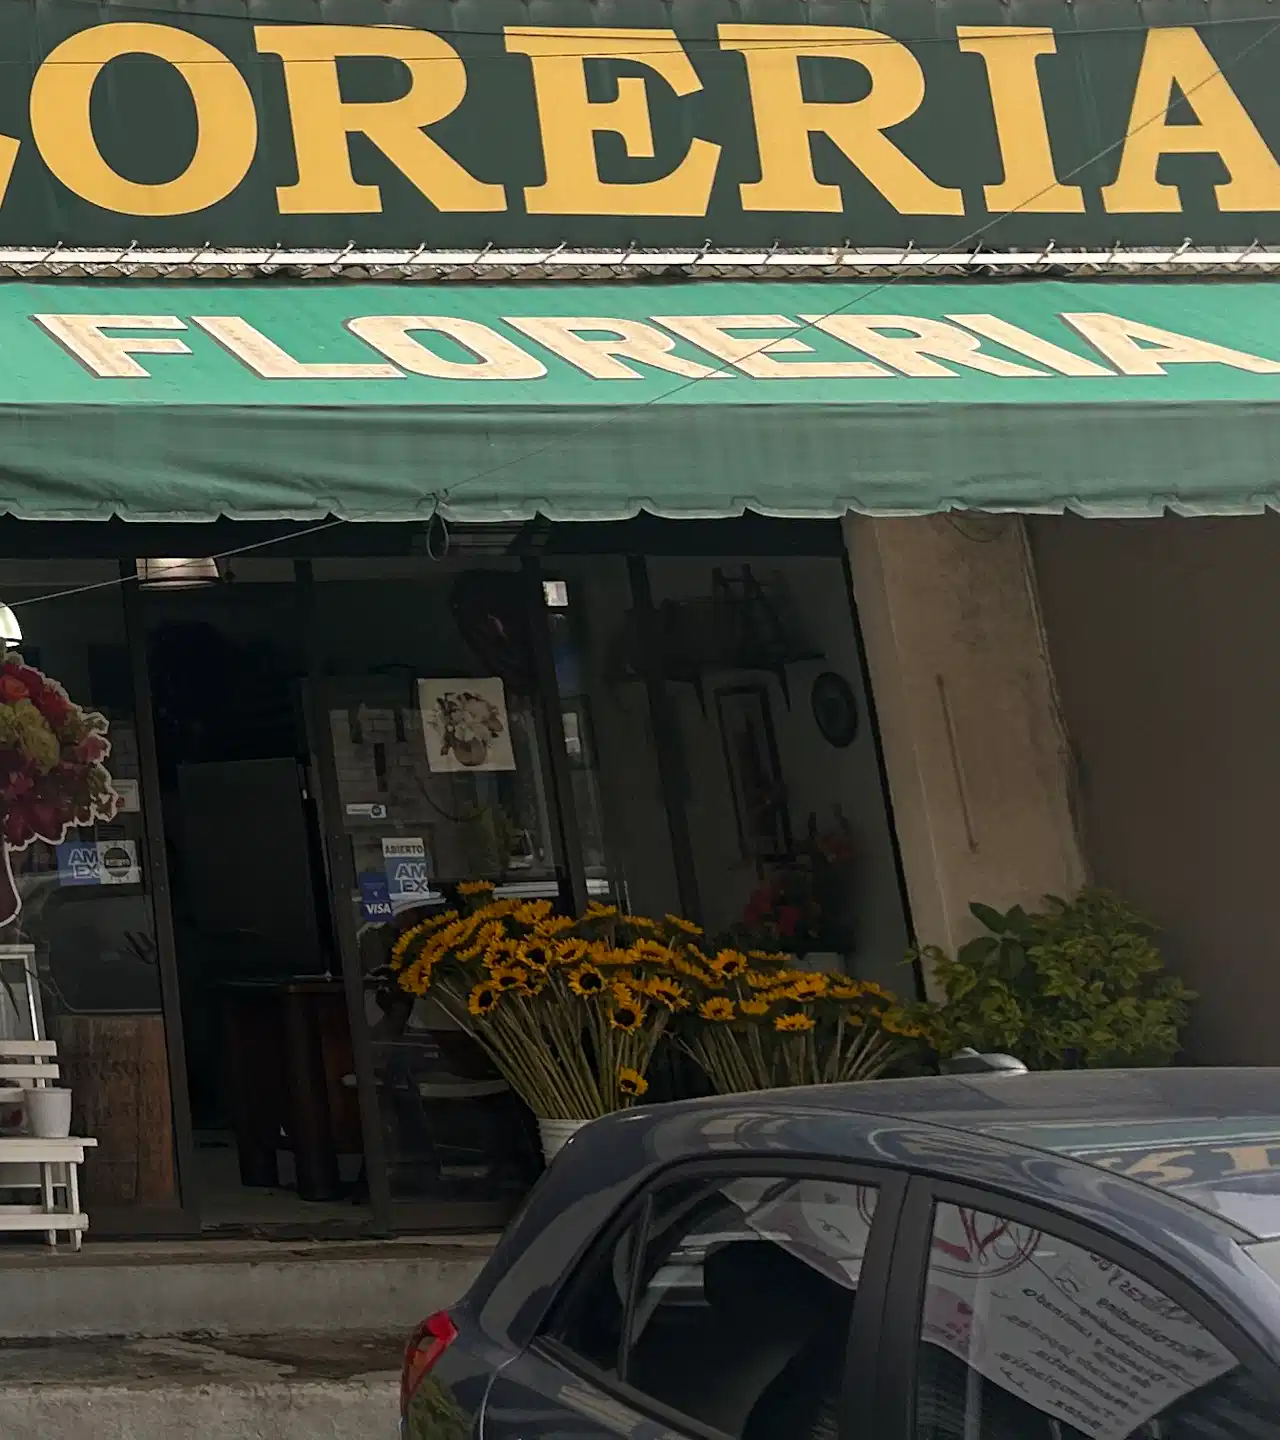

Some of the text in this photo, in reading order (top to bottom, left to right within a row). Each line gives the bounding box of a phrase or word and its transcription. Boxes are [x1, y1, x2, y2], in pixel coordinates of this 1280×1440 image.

[31, 312, 1280, 379] FLORERIA
[385, 844, 424, 855] ABIERTO
[365, 903, 392, 914] VISA
